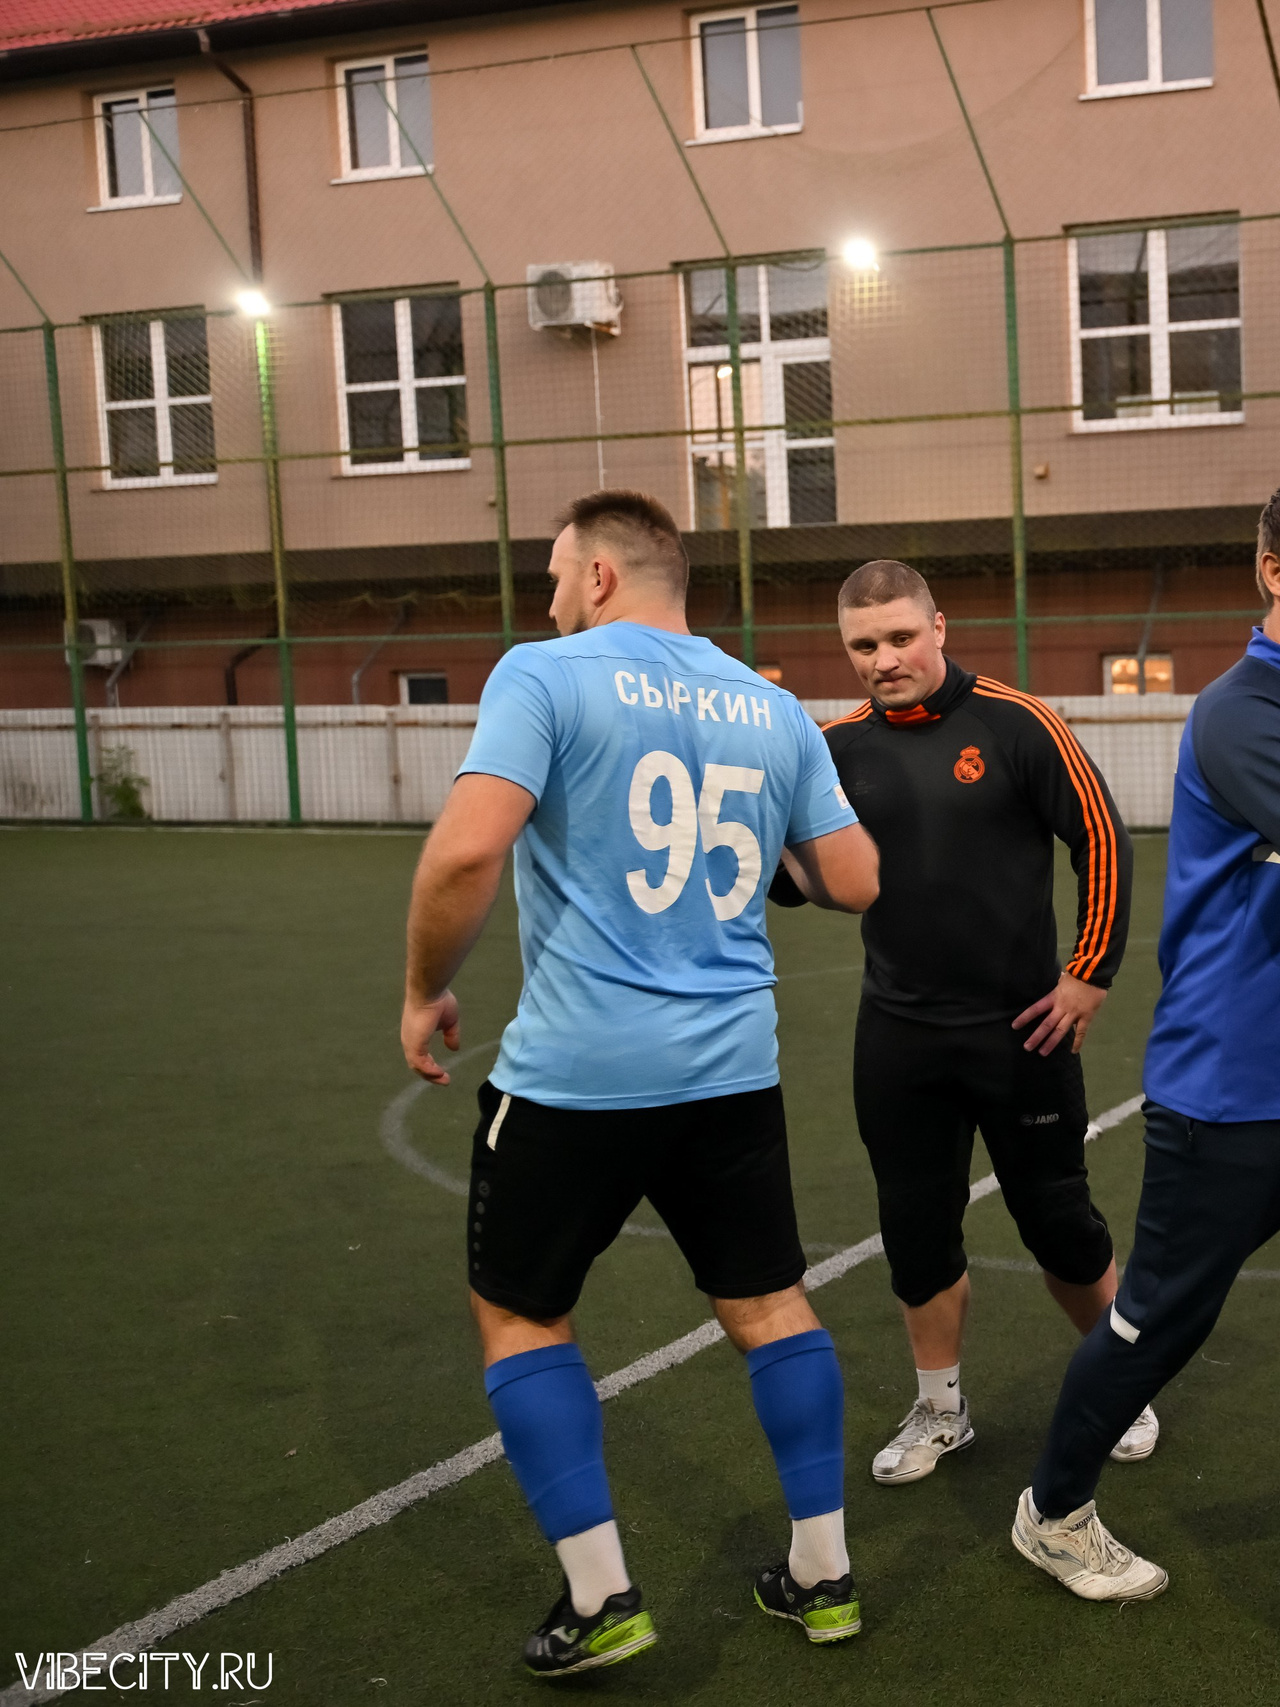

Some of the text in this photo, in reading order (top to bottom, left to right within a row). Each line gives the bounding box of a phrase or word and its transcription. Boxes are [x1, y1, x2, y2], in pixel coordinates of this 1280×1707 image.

[614, 670, 772, 730] СЫРКИН
[626, 750, 765, 921] 95
[1034, 1113, 1060, 1125] JAKO
